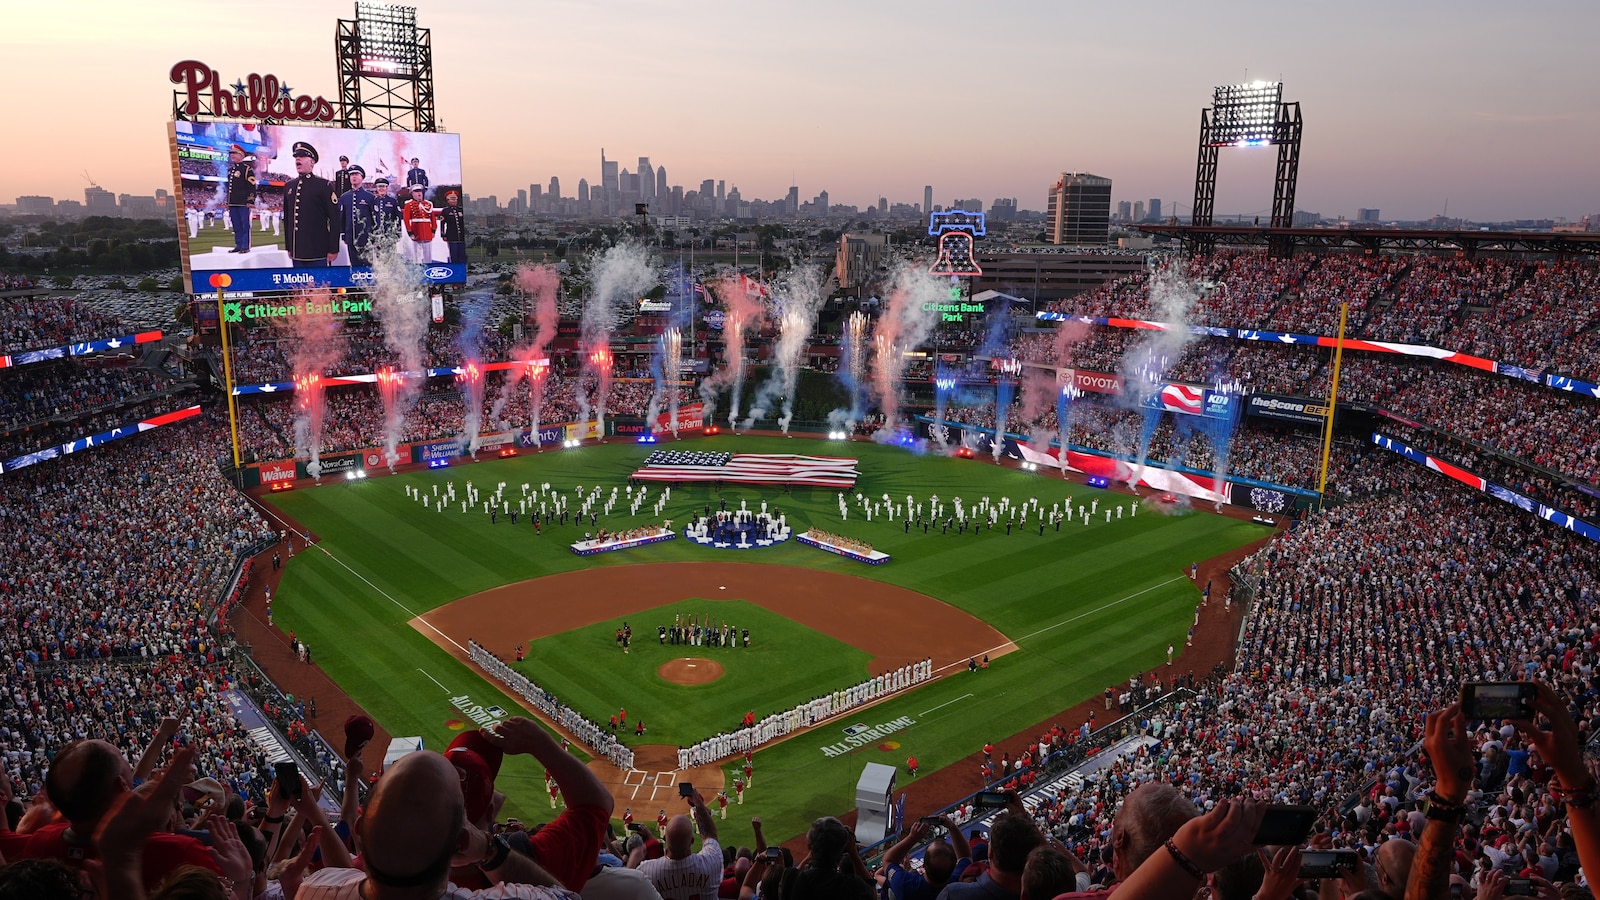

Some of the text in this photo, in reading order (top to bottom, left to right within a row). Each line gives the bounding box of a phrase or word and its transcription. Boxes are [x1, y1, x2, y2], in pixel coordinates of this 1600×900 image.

[170, 60, 334, 122] Phillies
[282, 273, 314, 284] Mobile
[429, 268, 448, 277] Ford
[244, 298, 372, 319] Citizens Bank Park
[922, 303, 984, 312] Citizens Bank
[942, 313, 963, 322] Park
[1076, 375, 1120, 390] TOYOTA
[1251, 396, 1330, 415] theScore BET
[617, 425, 644, 433] GIANT
[321, 458, 355, 468] NovaCare
[261, 469, 295, 482] Wawa
[448, 695, 493, 725] ALL STAR
[819, 715, 917, 758] ALL STAR GAME
[656, 872, 710, 893] ALLADAY
